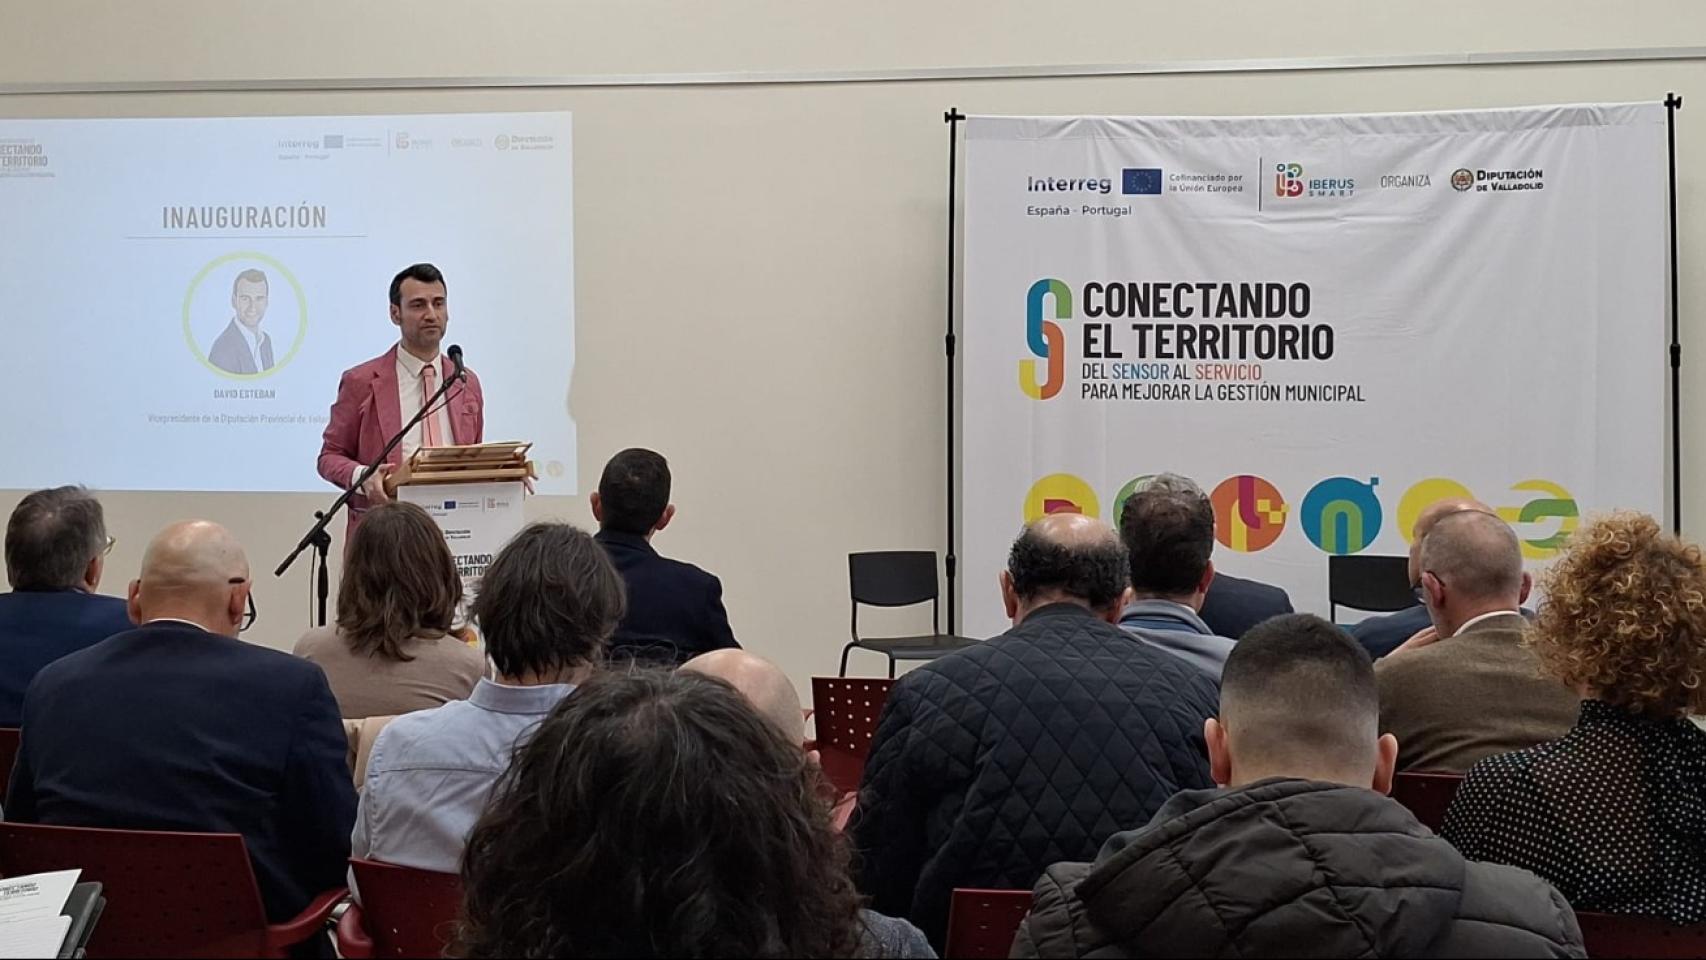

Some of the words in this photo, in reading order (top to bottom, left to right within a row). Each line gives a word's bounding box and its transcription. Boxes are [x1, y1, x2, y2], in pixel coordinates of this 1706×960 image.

[1027, 176, 1112, 195] Interreg
[1169, 173, 1226, 182] Cofinanciado
[1228, 175, 1243, 183] por
[1308, 178, 1355, 190] IBERUS
[1380, 174, 1432, 189] ORGANIZA
[1169, 184, 1178, 193] la
[1179, 183, 1206, 193] Unión
[1207, 184, 1244, 194] Europea
[1308, 189, 1355, 198] SMART
[162, 200, 327, 229] INAUGURACIÓN
[1027, 205, 1070, 217] España
[1082, 204, 1133, 217] Portugal
[1082, 282, 1312, 319] CONECTANDO
[1082, 323, 1123, 359] EL
[1131, 323, 1335, 361] TERRITORIO
[1082, 363, 1109, 380] DEL
[1112, 363, 1170, 380] SENSOR
[1173, 363, 1192, 381] AL
[1195, 363, 1263, 382] SERVICIO
[213, 389, 238, 400] DAVID
[1081, 383, 1118, 400] PARA
[1122, 383, 1191, 401] MEJORAR
[1194, 383, 1214, 401] LA
[1216, 381, 1280, 402] GESTIÓN
[1284, 384, 1367, 403] MUNICIPAL
